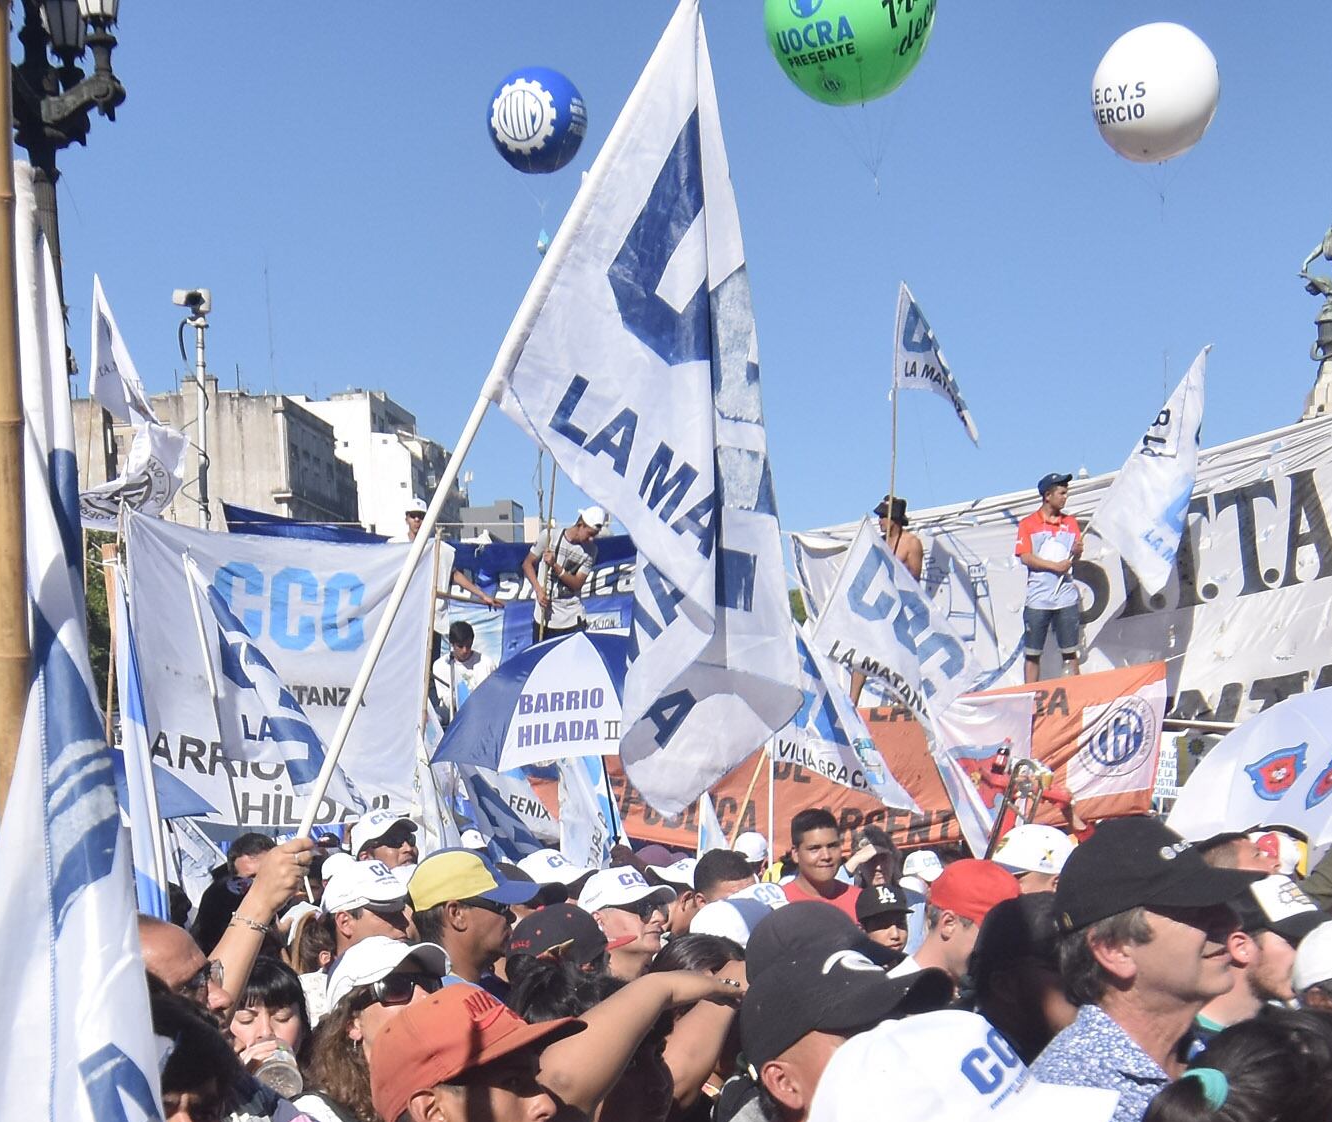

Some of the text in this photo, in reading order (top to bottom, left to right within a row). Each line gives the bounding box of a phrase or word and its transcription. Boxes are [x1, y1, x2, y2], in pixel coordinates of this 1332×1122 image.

[776, 15, 854, 55] UOCRA
[787, 42, 856, 69] PRESENTE
[904, 360, 918, 378] LA
[214, 560, 366, 653] CCC
[827, 639, 857, 670] LA
[517, 686, 604, 716] BARRIO
[517, 719, 599, 748] HILADA
[509, 794, 551, 821] FENIX
[876, 885, 897, 904] LA
